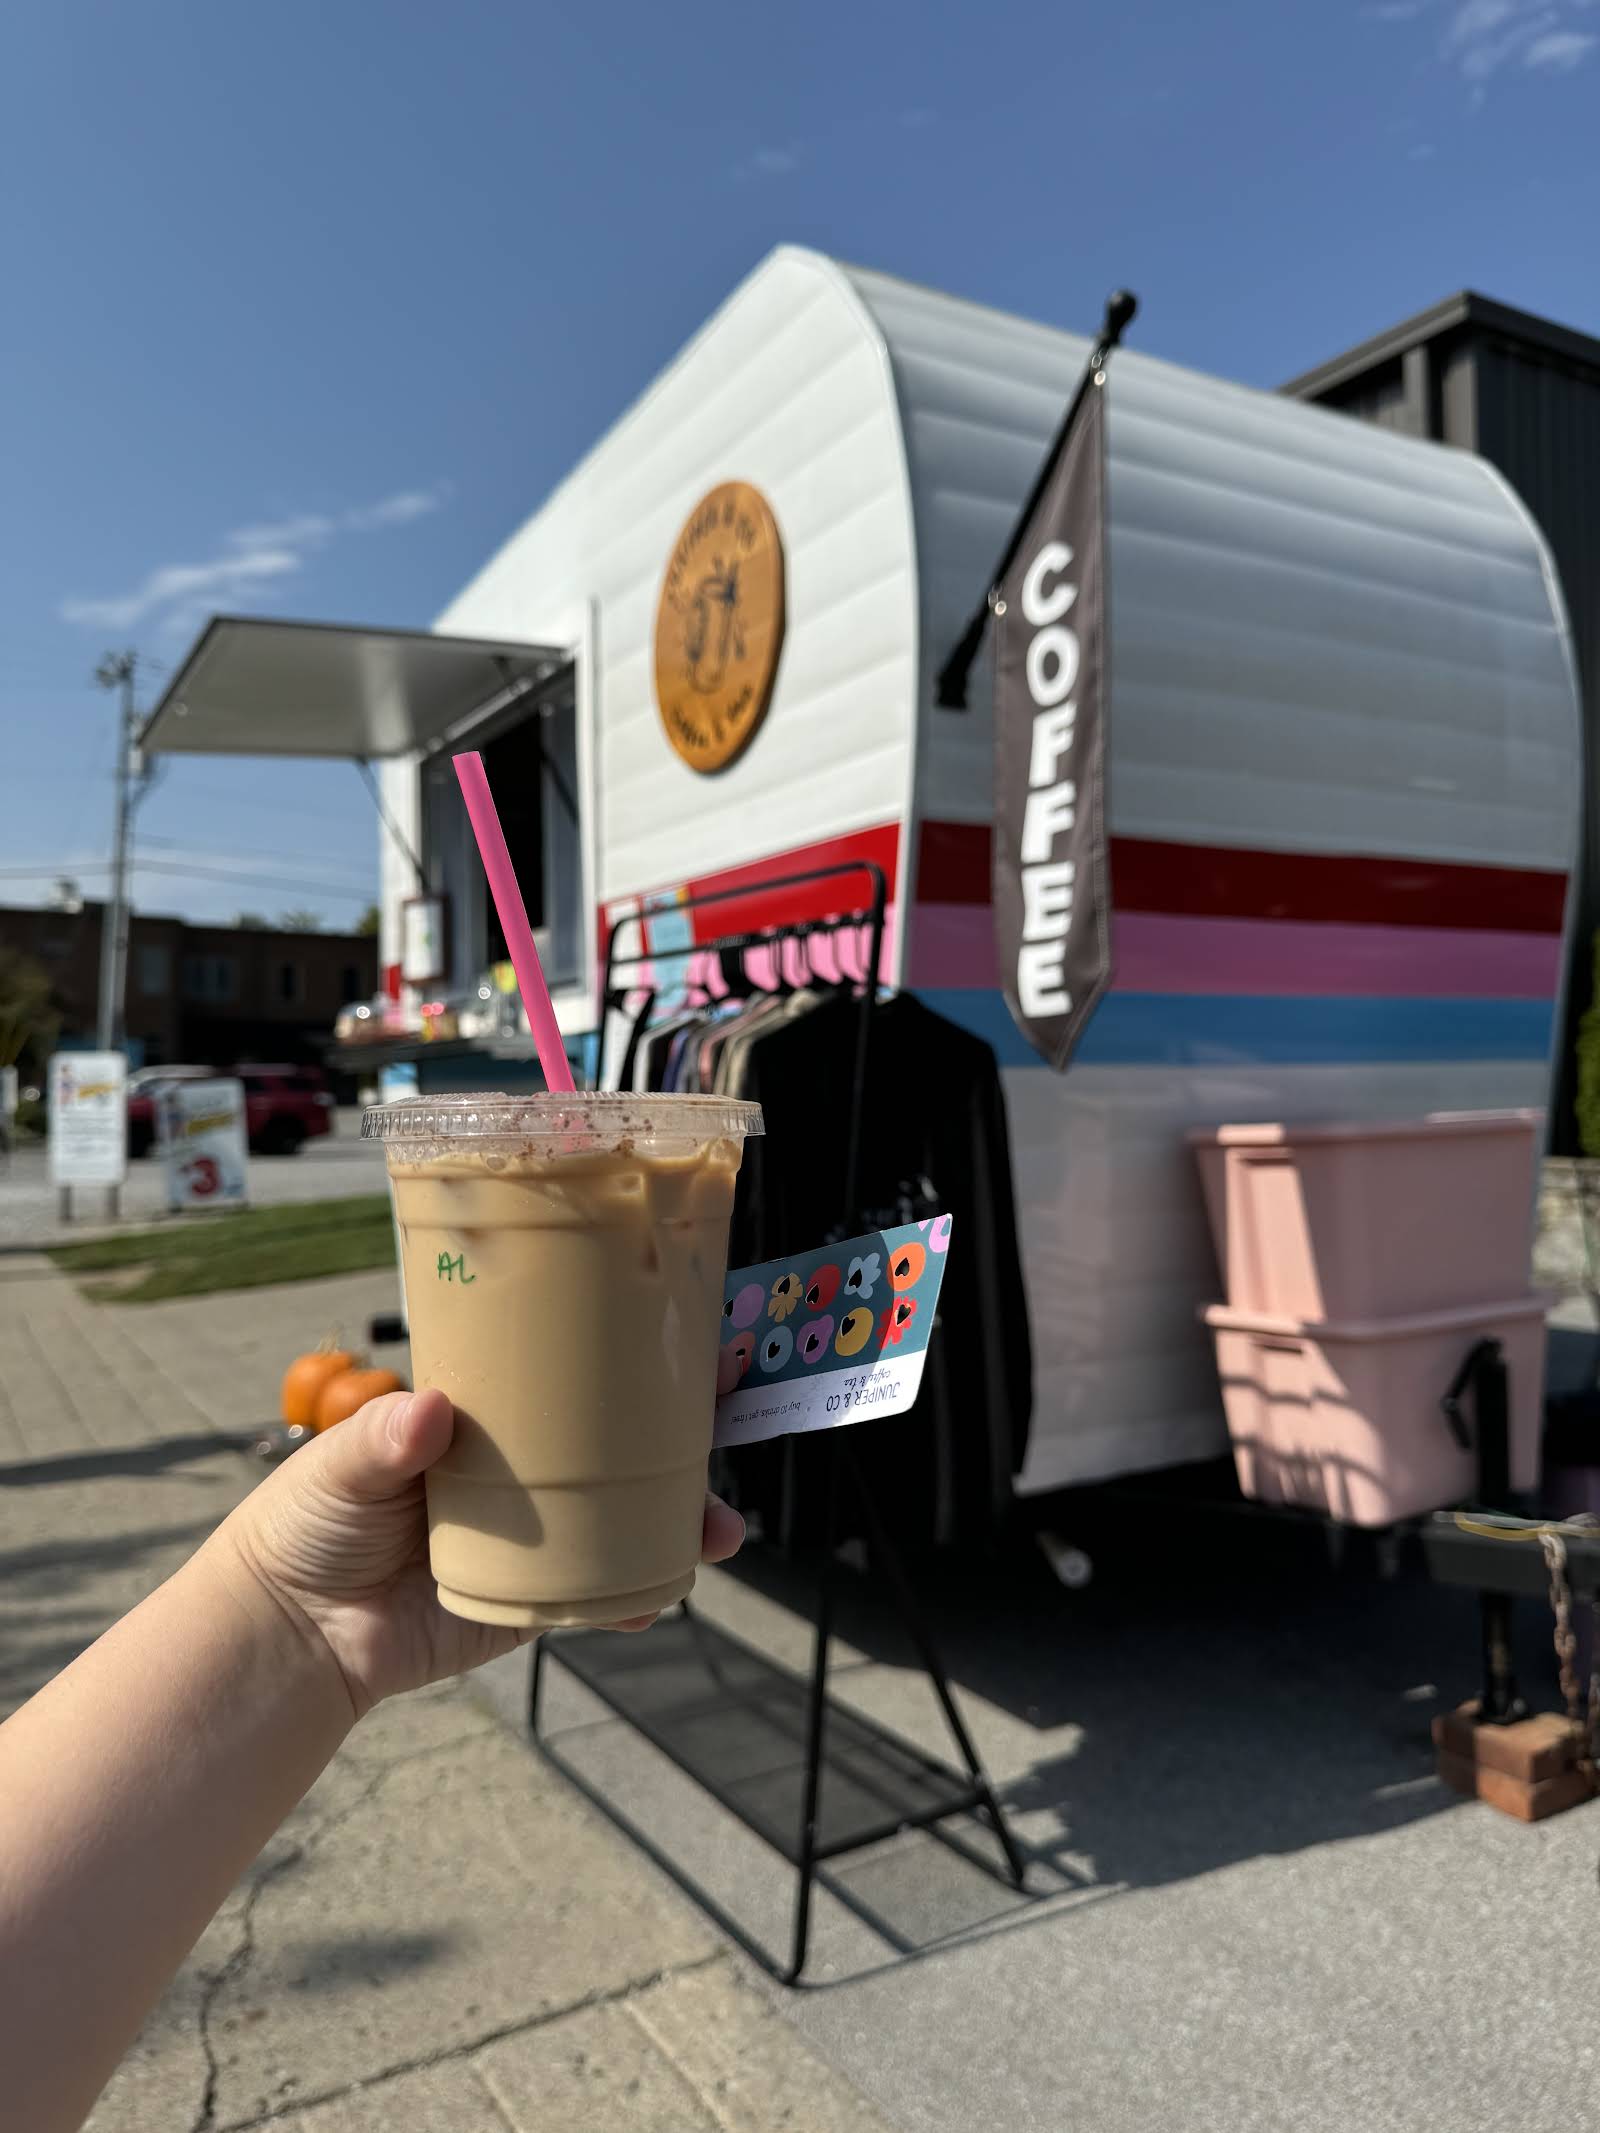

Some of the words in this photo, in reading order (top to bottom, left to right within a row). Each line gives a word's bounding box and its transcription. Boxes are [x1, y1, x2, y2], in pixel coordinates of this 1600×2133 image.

[1017, 541, 1081, 1018] COFFEE
[859, 1375, 866, 1388] &
[868, 1368, 891, 1384] coffee
[844, 1377, 857, 1391] tea
[844, 1392, 852, 1408] &
[854, 1382, 901, 1406] JUNIPER
[780, 1404, 788, 1415] 10
[788, 1401, 801, 1412] buy
[826, 1394, 841, 1412] CO
[749, 1409, 760, 1421] get
